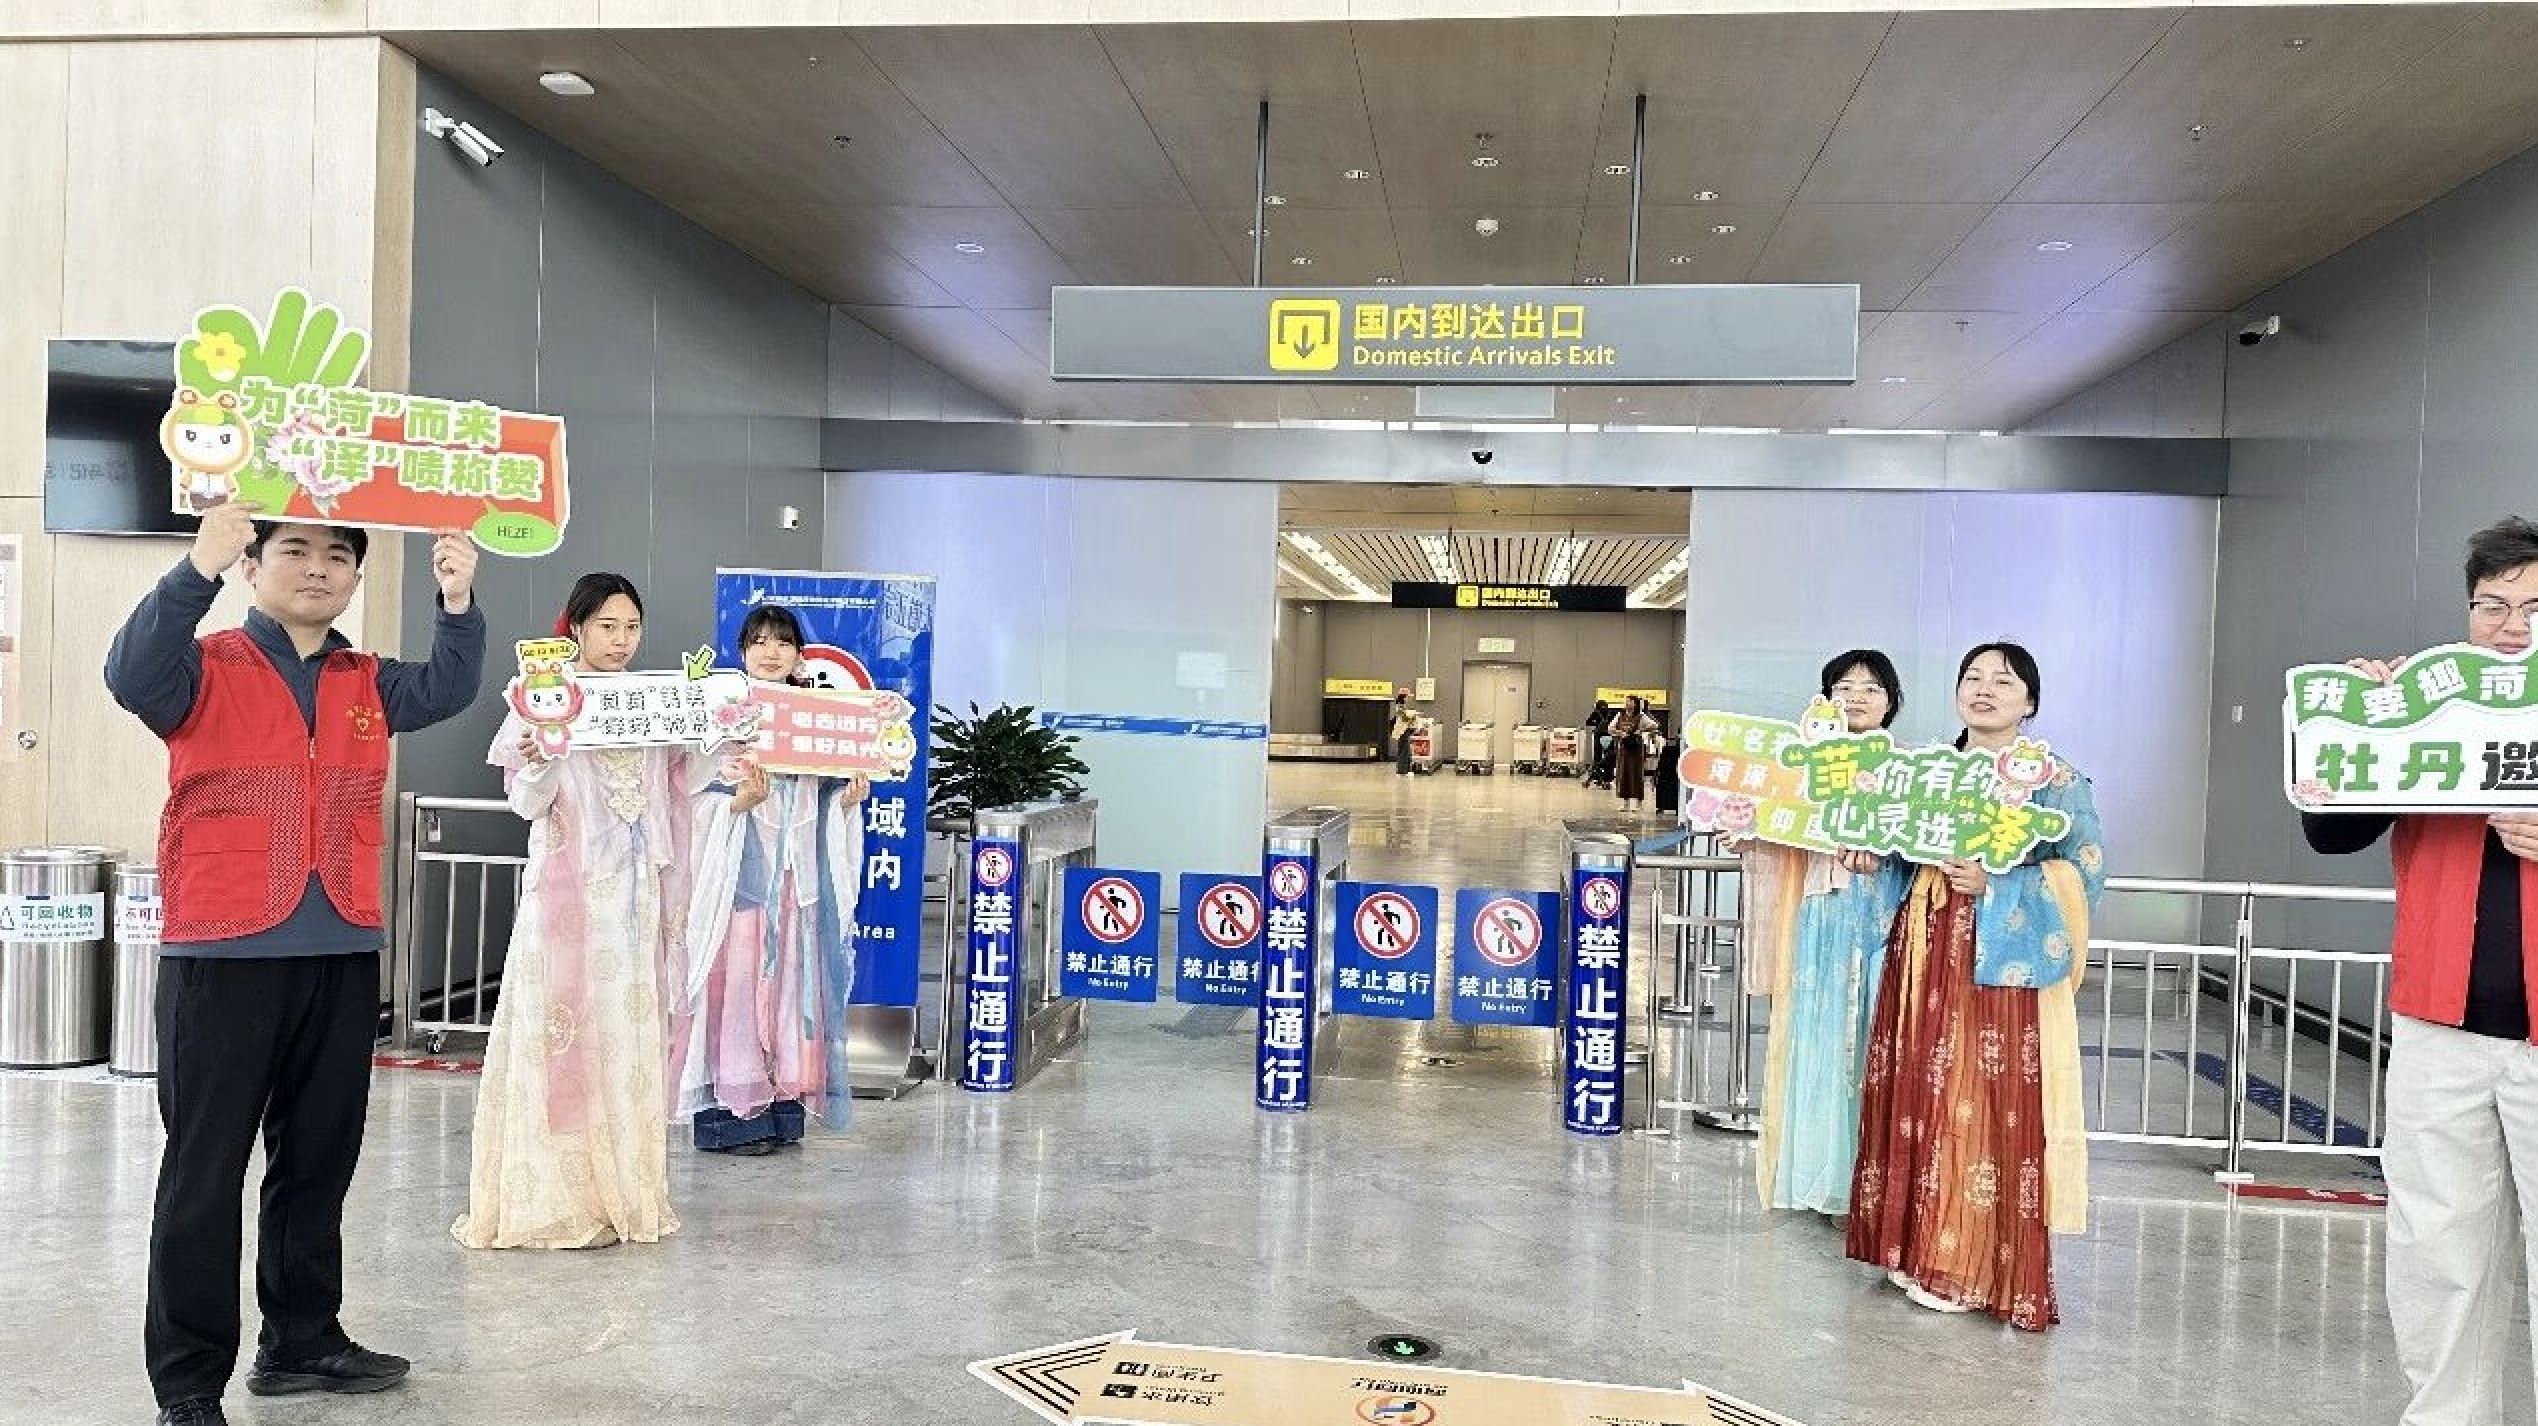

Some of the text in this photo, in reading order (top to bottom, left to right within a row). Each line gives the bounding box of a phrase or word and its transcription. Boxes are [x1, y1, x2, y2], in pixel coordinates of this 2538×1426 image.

[1353, 303, 1585, 340] 国内到达出口
[1353, 345, 1615, 365] Domestic Arrivals Exit
[1066, 951, 1153, 978] 禁止通行
[967, 891, 1013, 1082] 禁止通行
[1339, 967, 1431, 995] 禁止通行
[1457, 975, 1553, 1001] 禁止通行
[1263, 905, 1307, 1101] 禁止通行
[1573, 923, 1621, 1125] 禁止通行
